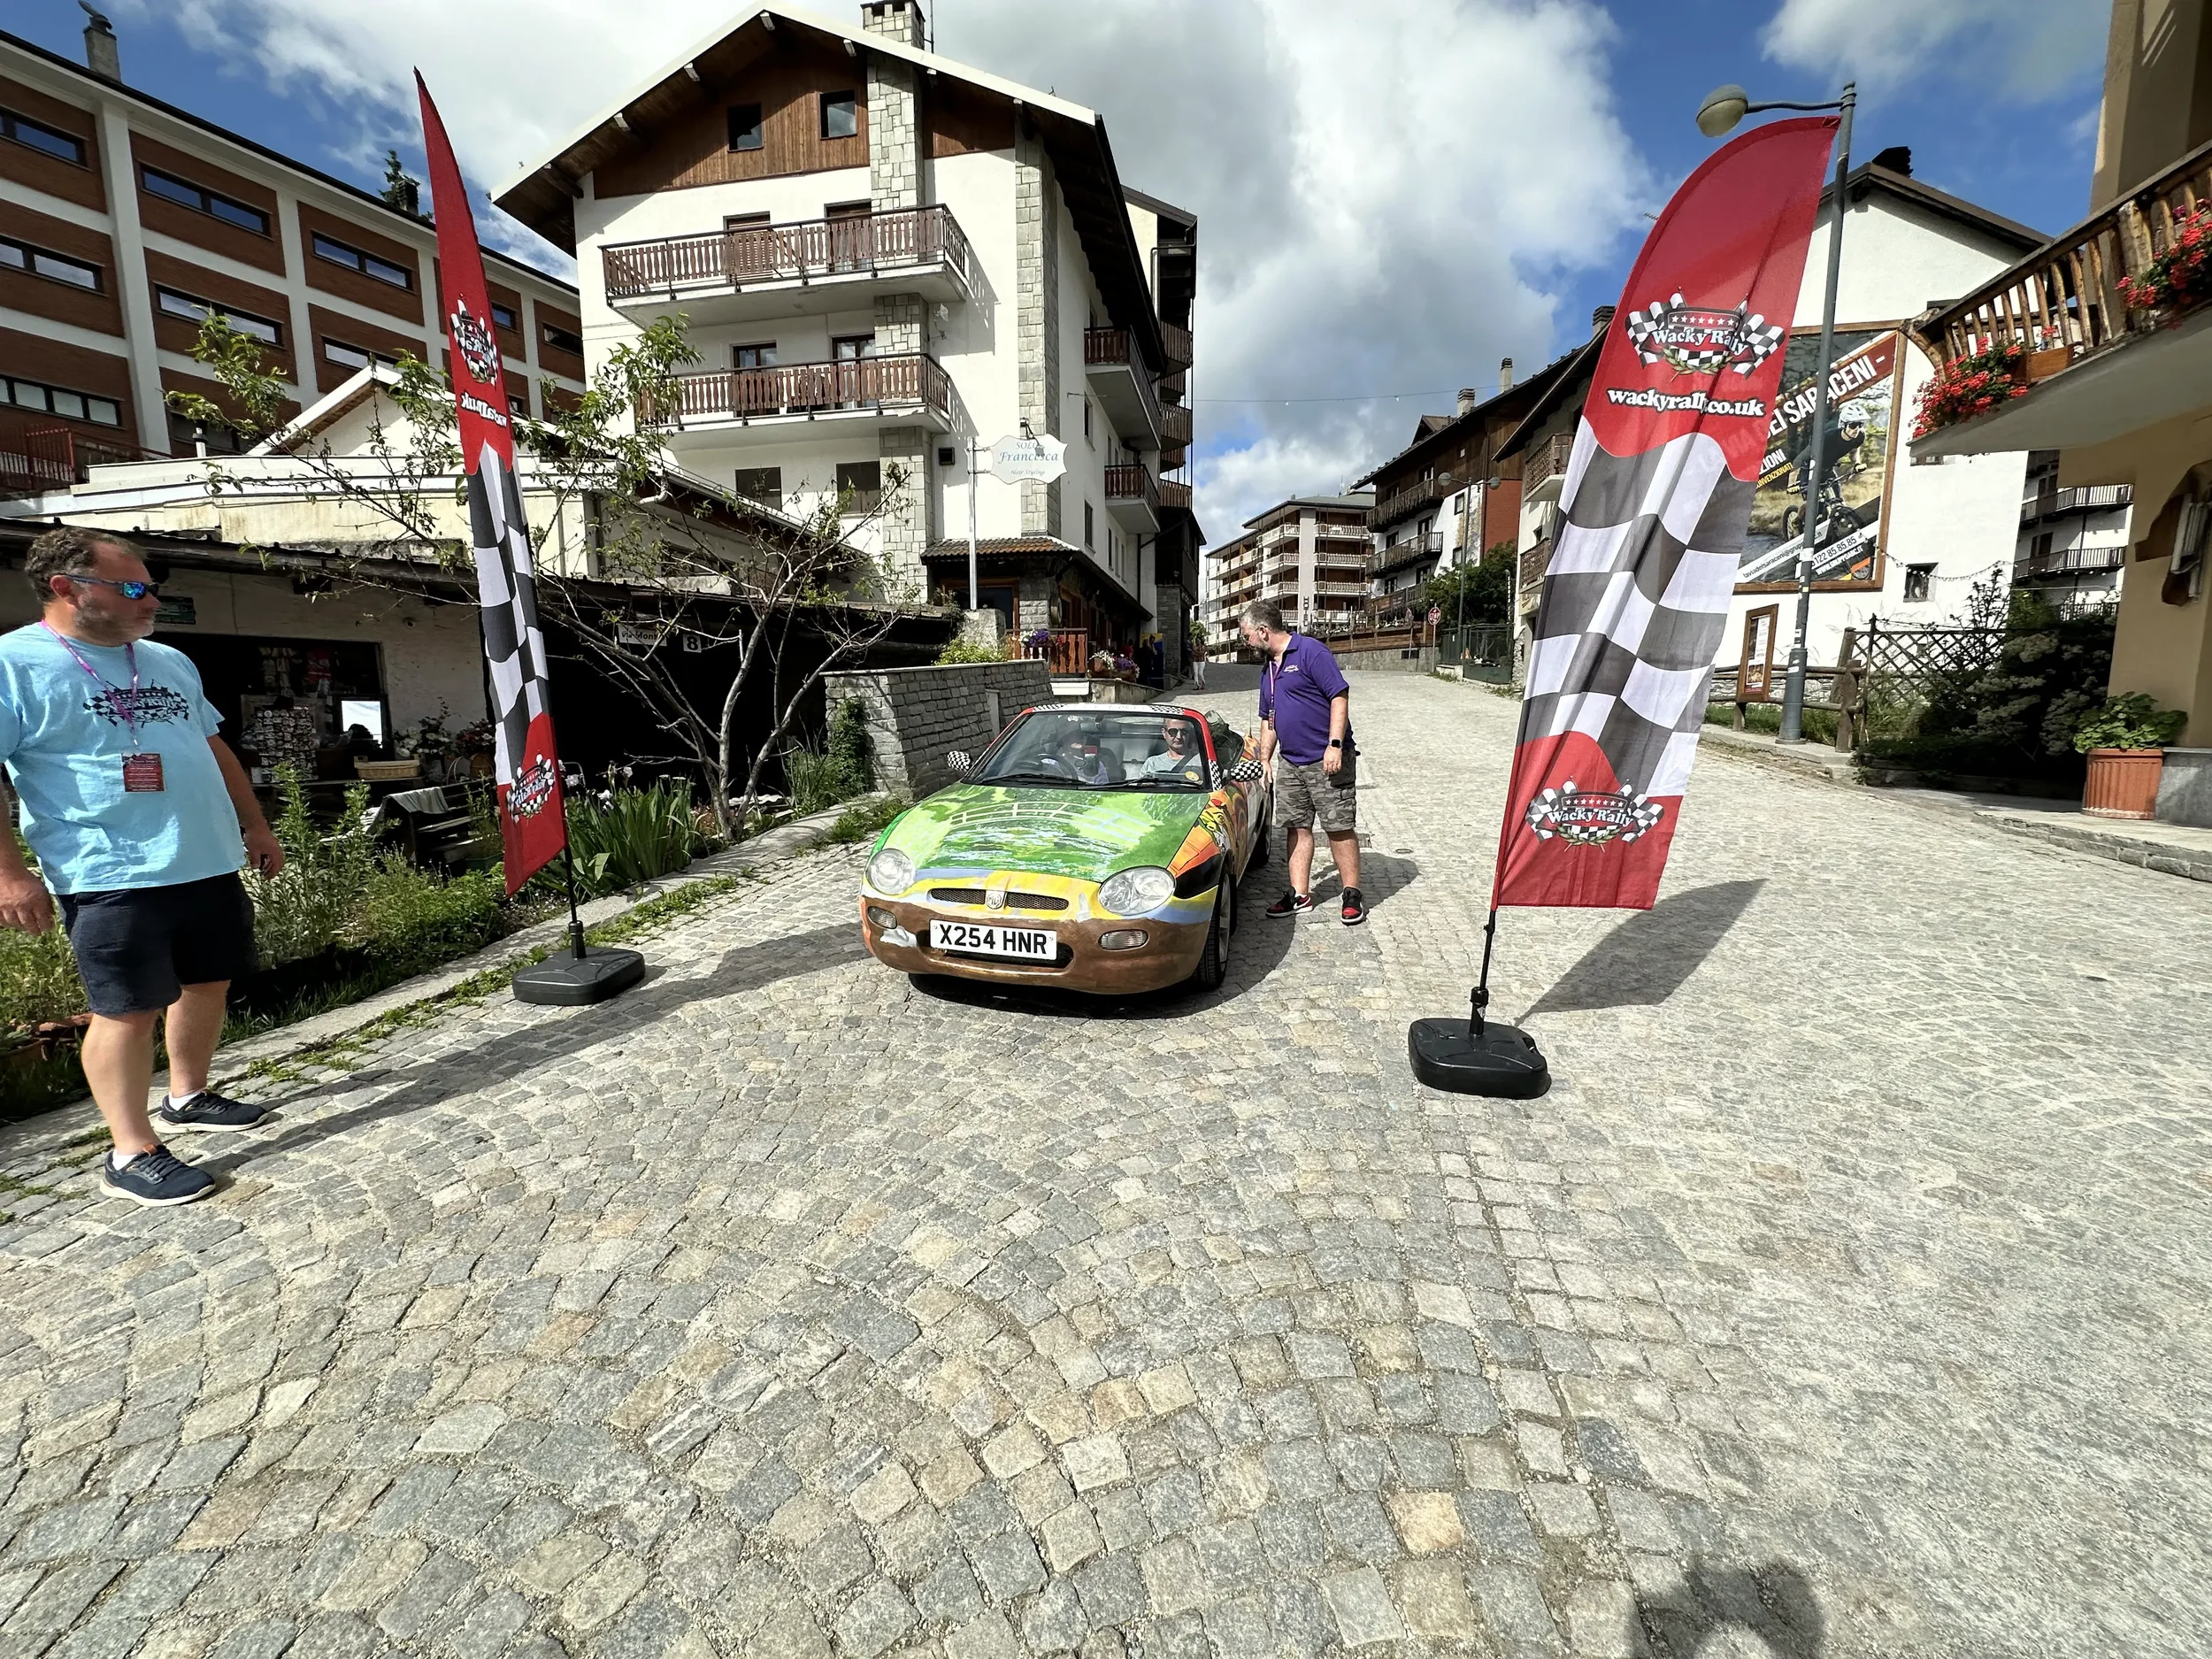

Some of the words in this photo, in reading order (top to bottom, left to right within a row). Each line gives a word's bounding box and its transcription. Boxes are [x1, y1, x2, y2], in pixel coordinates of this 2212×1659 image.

[1652, 328, 1705, 346] Wacky
[1711, 330, 1748, 355] Rally
[1607, 388, 1764, 417] wackyrally.co.uk
[998, 451, 1058, 465] Francesca
[687, 636, 699, 650] 8
[1548, 809, 1594, 823] Wacky
[1596, 810, 1634, 827] Rally
[940, 924, 996, 949] X254
[1002, 930, 1048, 955] HNR
